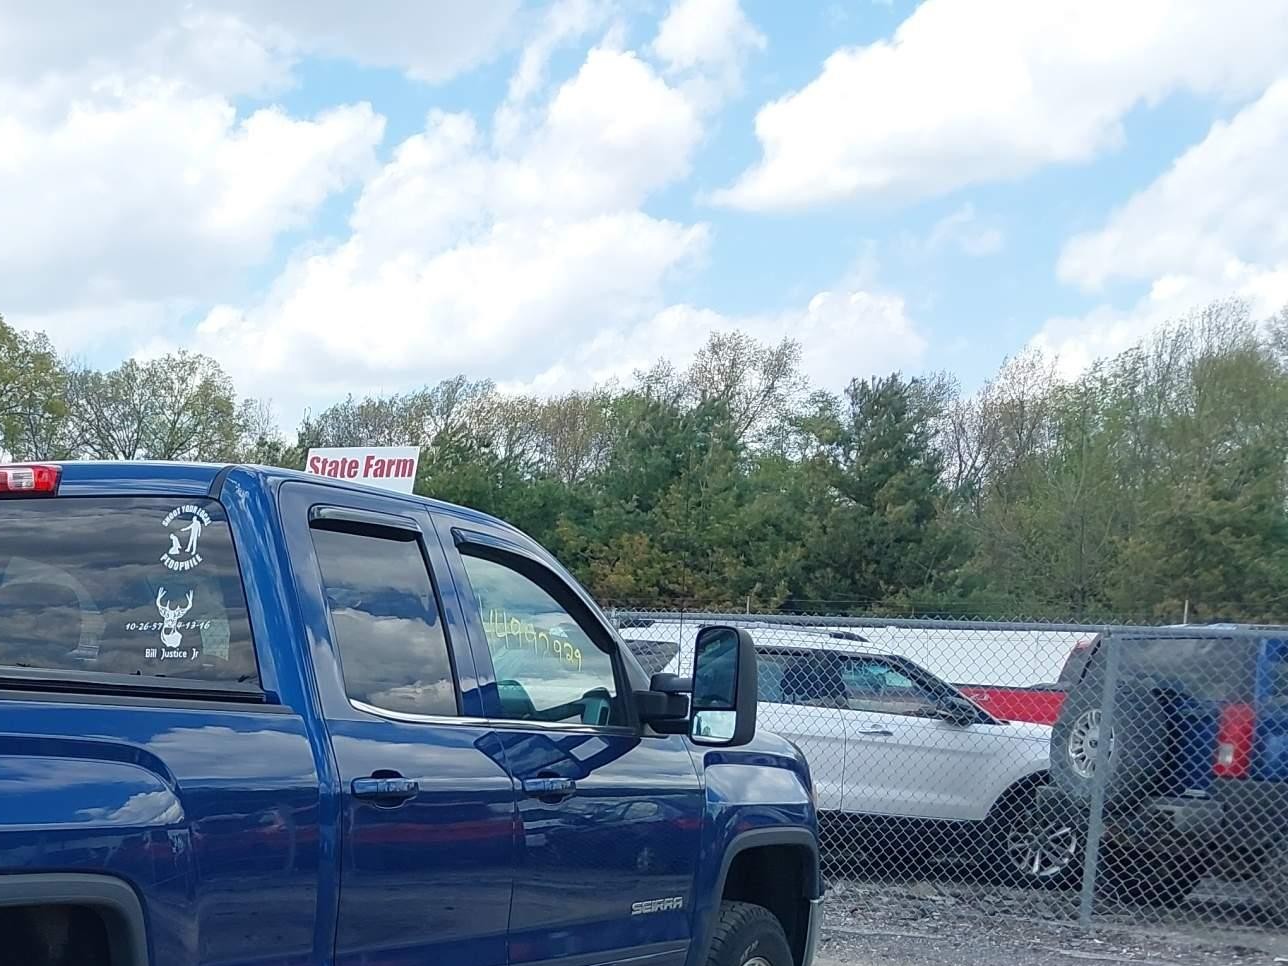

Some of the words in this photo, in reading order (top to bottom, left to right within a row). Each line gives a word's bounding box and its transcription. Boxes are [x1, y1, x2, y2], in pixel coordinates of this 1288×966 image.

[309, 456, 359, 479] State
[363, 455, 415, 478] Farm
[162, 507, 181, 527] SHOOT
[181, 504, 198, 514] YOUR
[197, 507, 212, 527] LOCAL
[160, 553, 203, 571] PEDOPHILE
[145, 648, 157, 658] Bill
[160, 648, 187, 660] Justice
[191, 648, 199, 660] Jr
